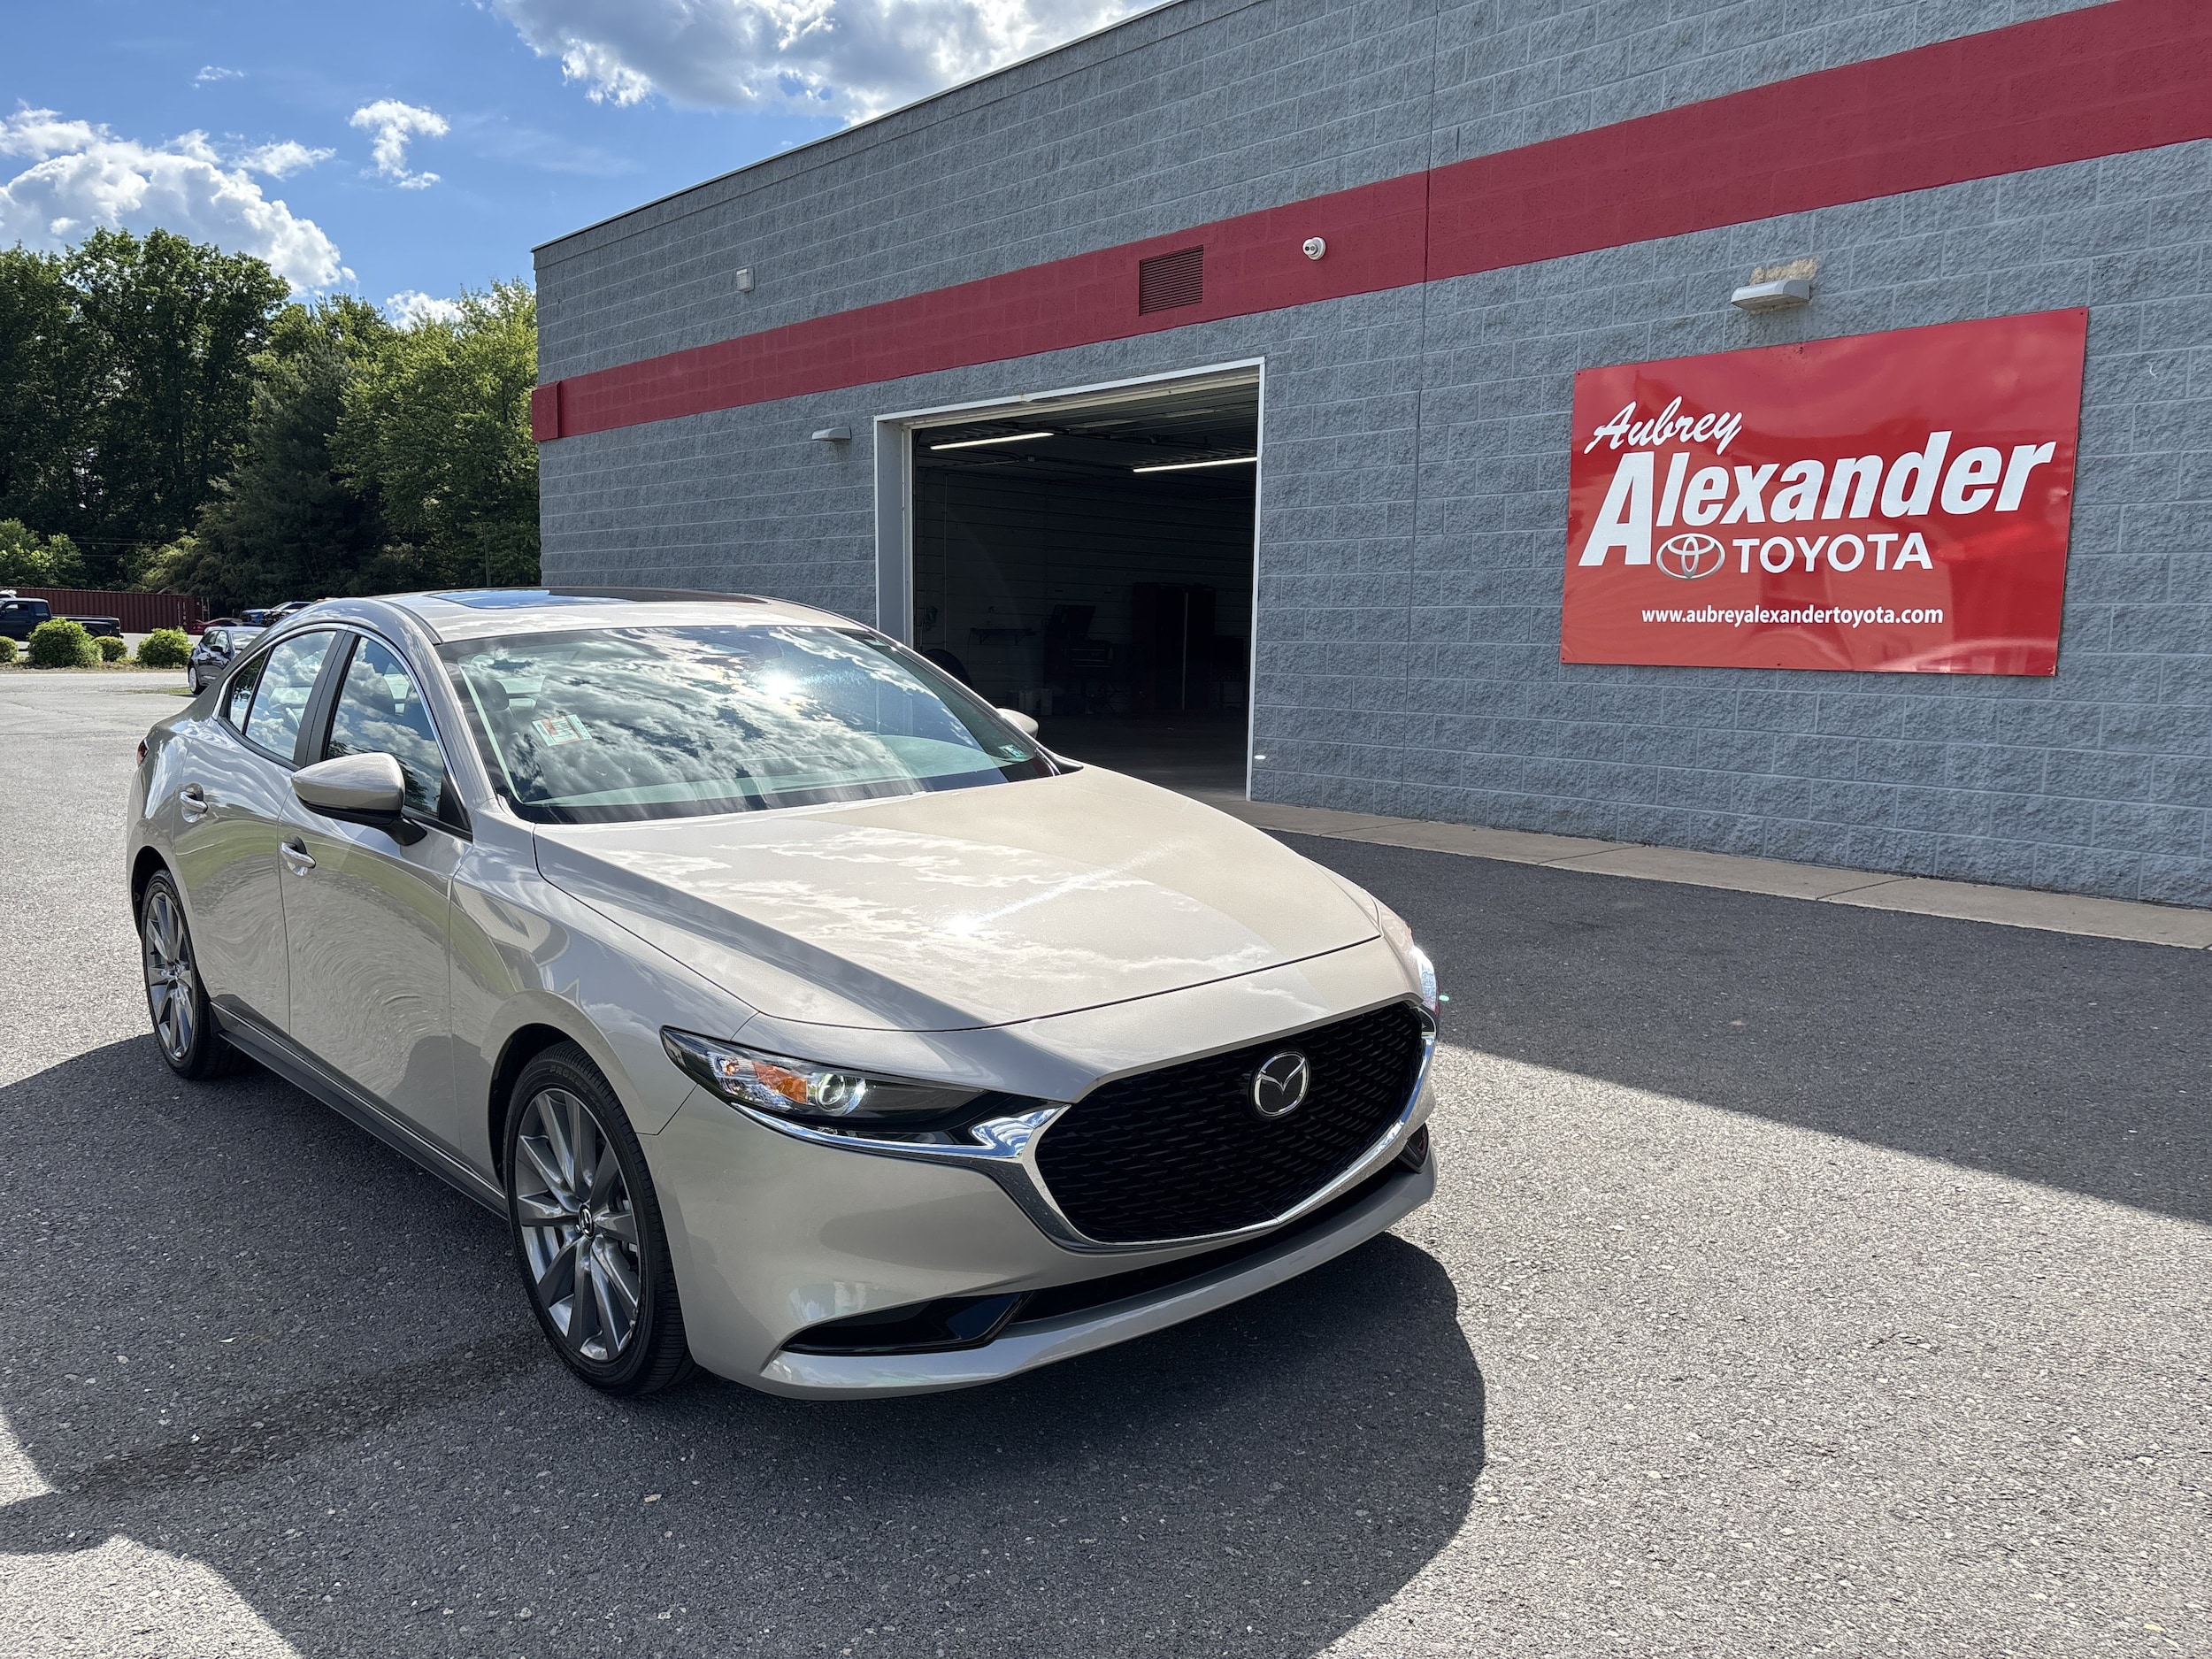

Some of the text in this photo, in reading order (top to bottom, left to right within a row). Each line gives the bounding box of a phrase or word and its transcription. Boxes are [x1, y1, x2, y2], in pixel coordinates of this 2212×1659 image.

[1584, 396, 1742, 455] Aubrey
[1578, 431, 2057, 567] Alexander
[1732, 532, 1933, 573] TOYOTA
[1641, 604, 1944, 628] www.aubreyalexandertoyota.com
